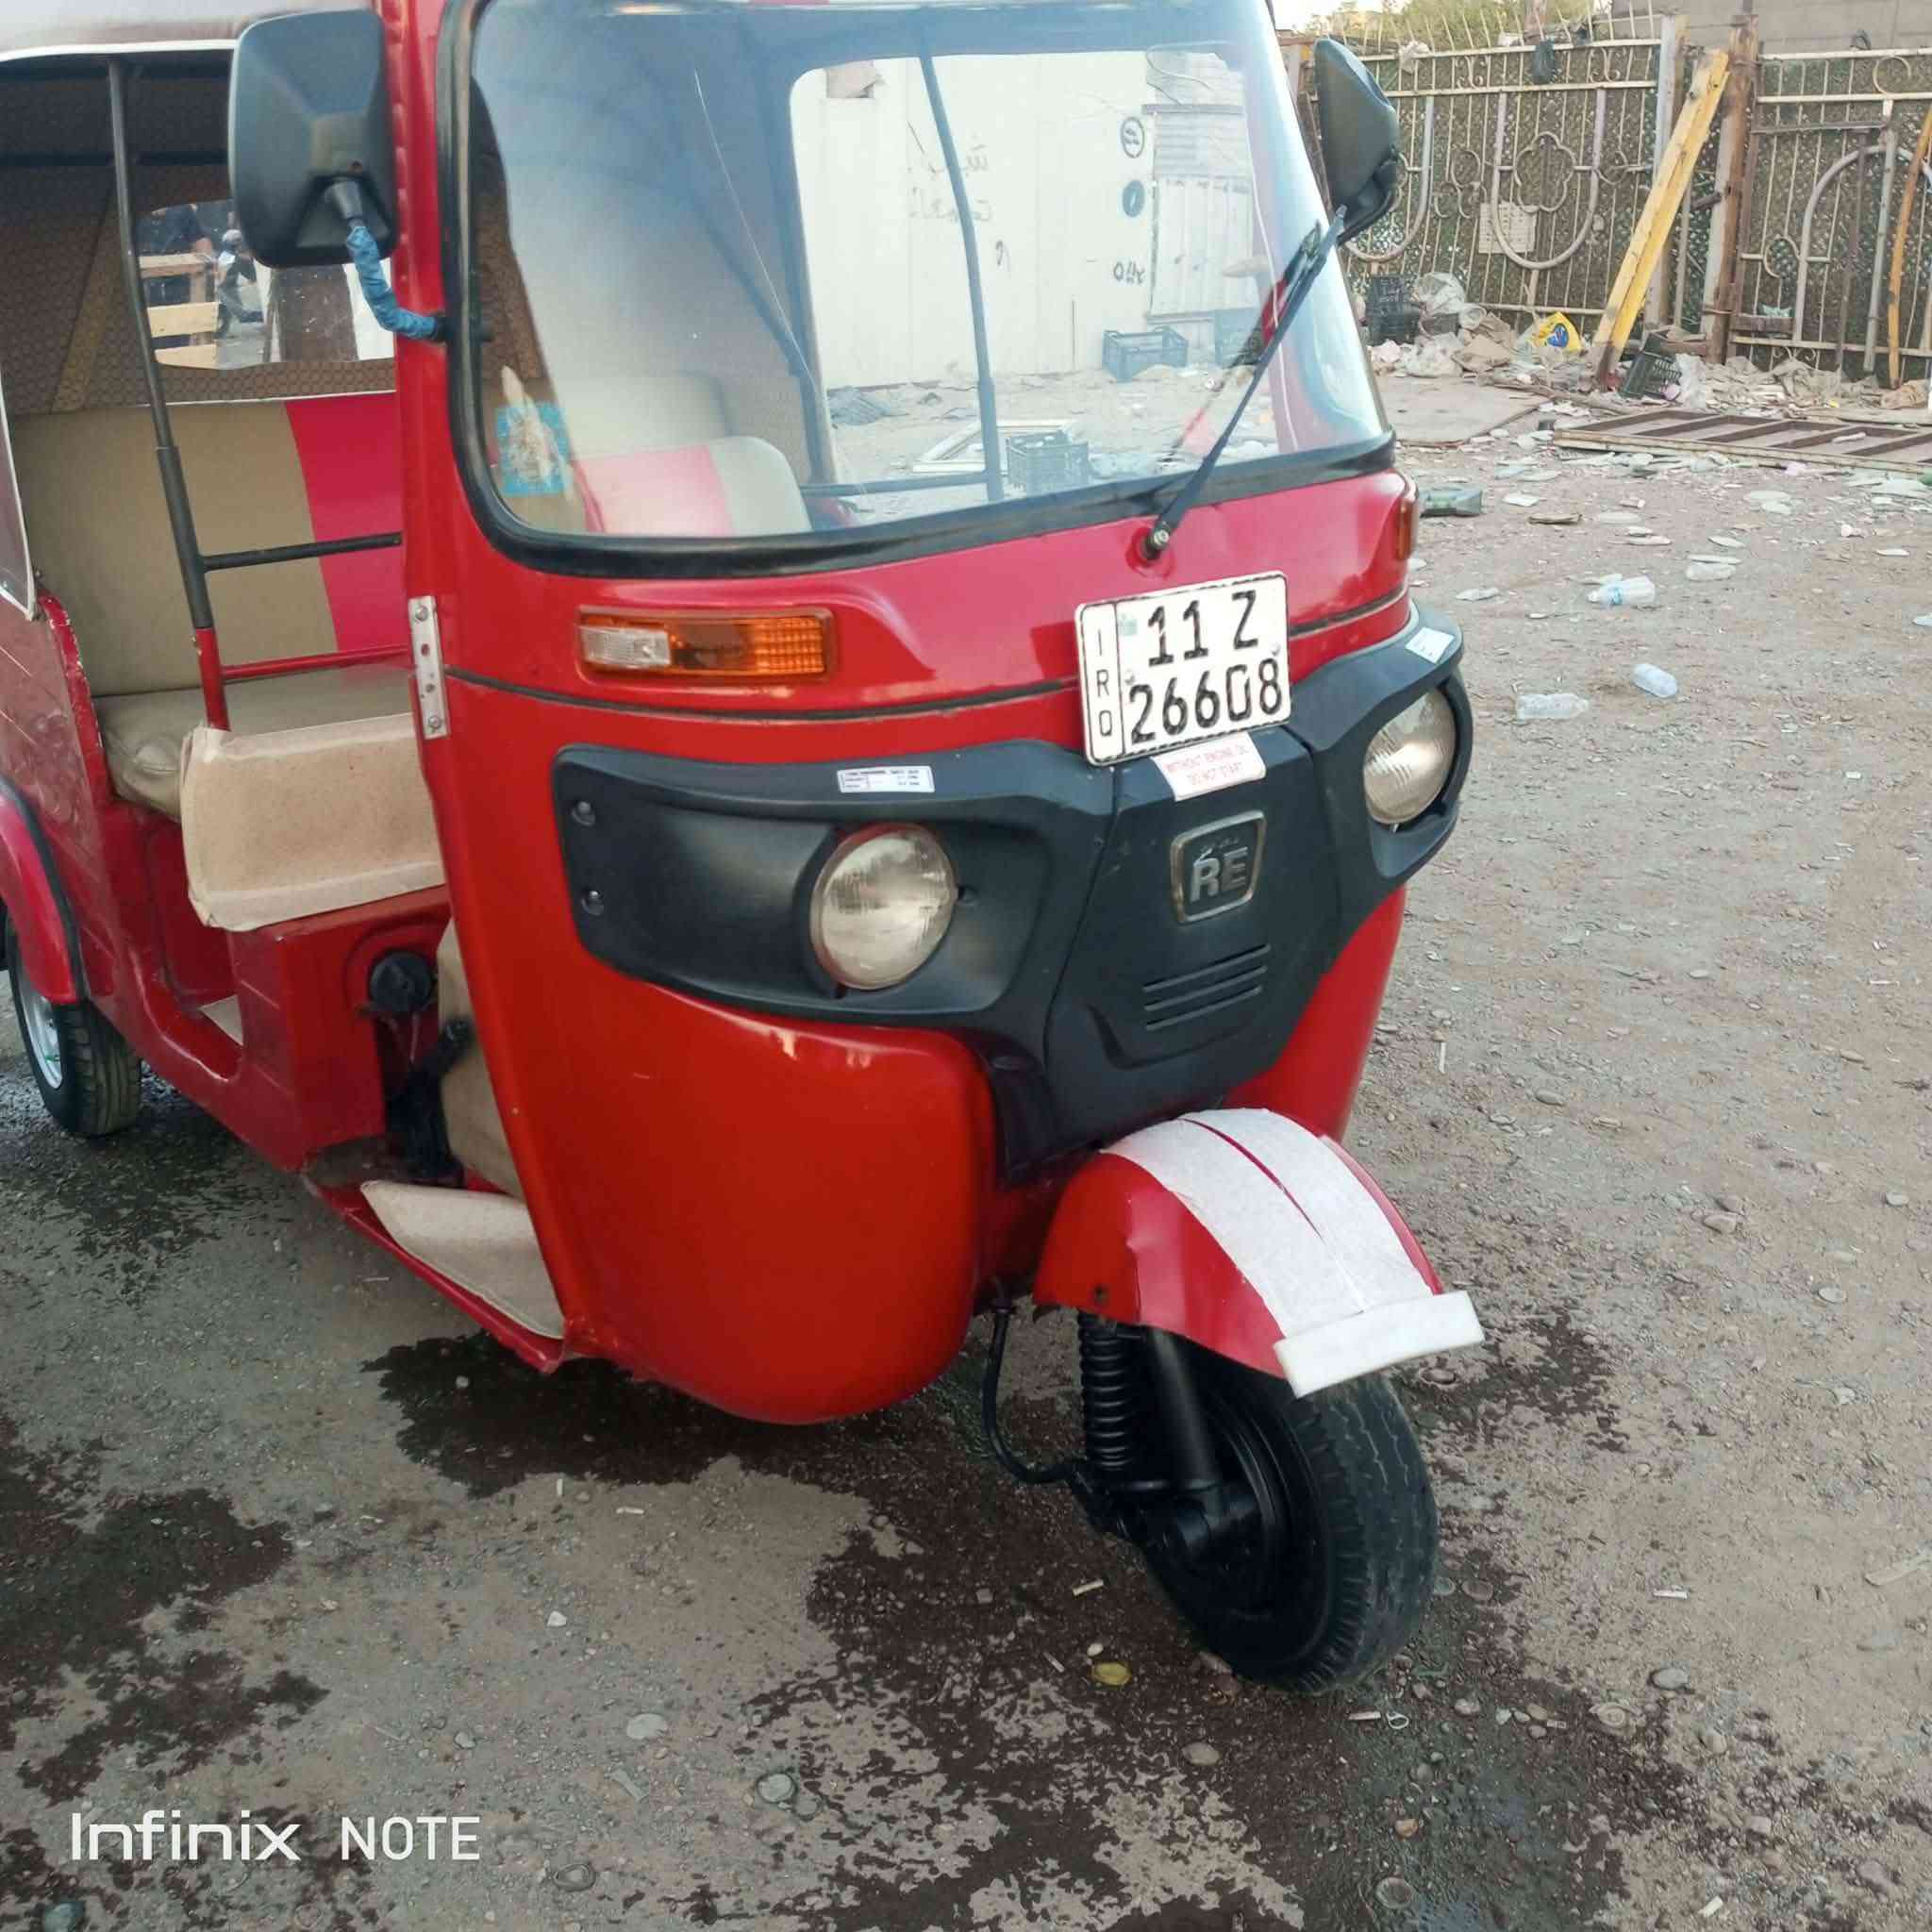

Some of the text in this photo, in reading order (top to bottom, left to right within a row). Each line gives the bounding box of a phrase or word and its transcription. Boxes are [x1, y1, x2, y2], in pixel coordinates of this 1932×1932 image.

[1147, 590, 1258, 667] 11 Z
[1095, 628, 1113, 737] IRQ
[1128, 658, 1283, 744] 26608
[1191, 846, 1248, 904] RE
